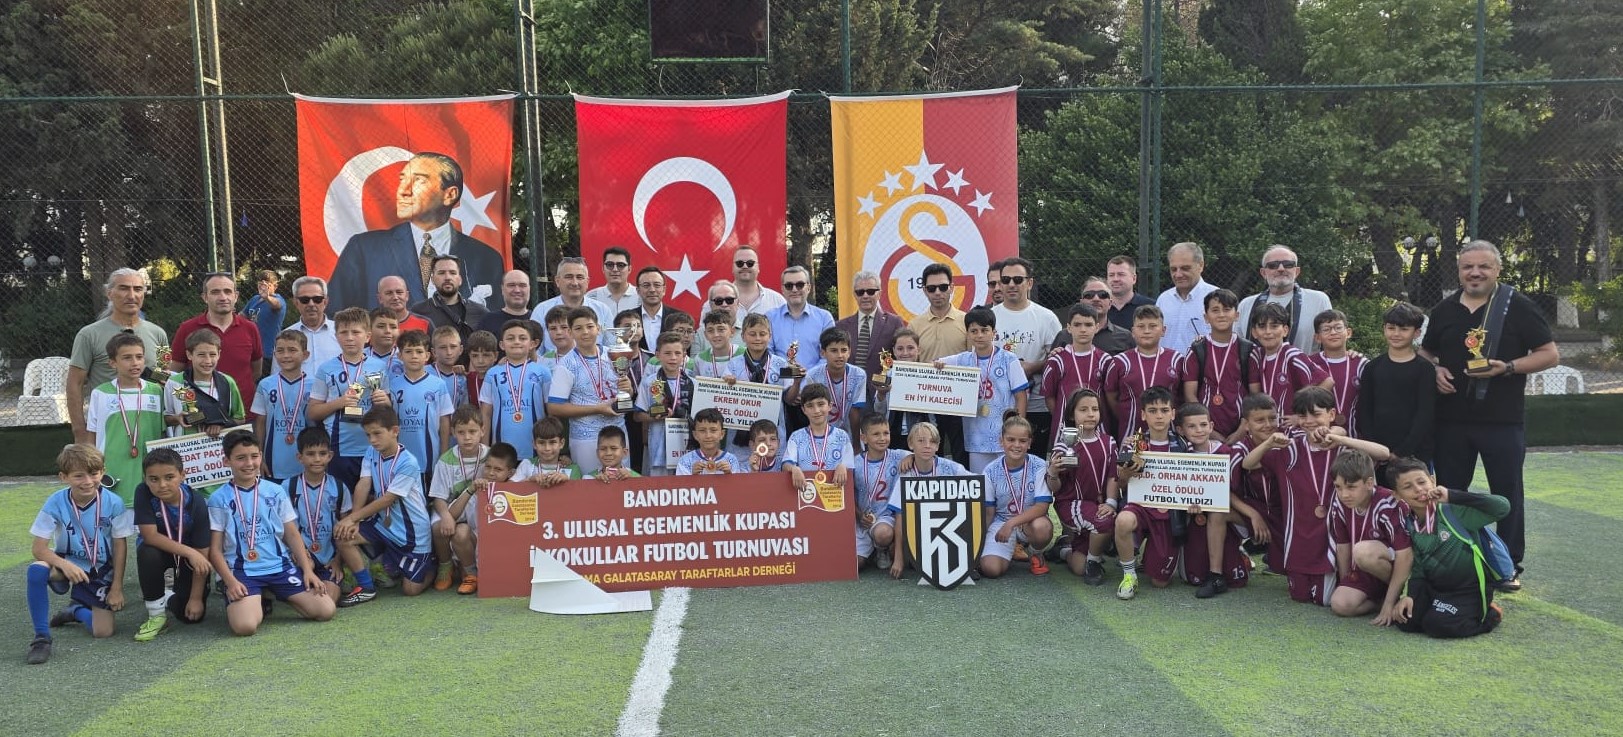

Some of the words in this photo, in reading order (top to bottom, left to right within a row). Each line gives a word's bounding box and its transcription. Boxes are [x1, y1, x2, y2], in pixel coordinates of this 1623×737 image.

[907, 277, 923, 290] 19
[331, 371, 348, 387] 10
[917, 383, 952, 393] TURNUVA
[270, 389, 277, 403] 8
[396, 389, 403, 403] 2
[713, 395, 739, 405] EKREM
[741, 398, 762, 408] OKUR
[916, 393, 927, 402] İYİ
[929, 396, 963, 406] KALECİSİ
[733, 407, 758, 418] ÖDÜLÜ
[737, 418, 757, 426] YILD
[180, 452, 201, 463] EDAT
[184, 466, 202, 475] ZEL
[186, 474, 209, 484] TBOL
[210, 470, 232, 480] YILD
[1158, 472, 1188, 481] ORHAN
[1190, 473, 1225, 483] AKKAYA
[876, 481, 887, 501] 2
[905, 480, 981, 500] KAPIDAG
[1151, 483, 1172, 493] ÖZEL
[1175, 484, 1204, 495] ÖDÜLÜ
[623, 487, 718, 508] BANDIRMA
[1143, 494, 1178, 503] FUTBOL
[1181, 497, 1213, 506] YILDIZI
[229, 499, 237, 516] 9
[542, 521, 559, 540] 3.
[563, 518, 629, 539] ULUSAL
[633, 510, 732, 536] EGEMENLİK
[735, 511, 796, 532] KUPASI
[643, 541, 709, 562] FUTBOL
[713, 537, 809, 559] TURNUVASI
[399, 556, 418, 571] 11
[603, 570, 678, 584] GALATASARAY
[680, 566, 750, 580] TARAFTARLAR
[752, 562, 796, 576] DERNEĞİ
[288, 576, 302, 587] 9
